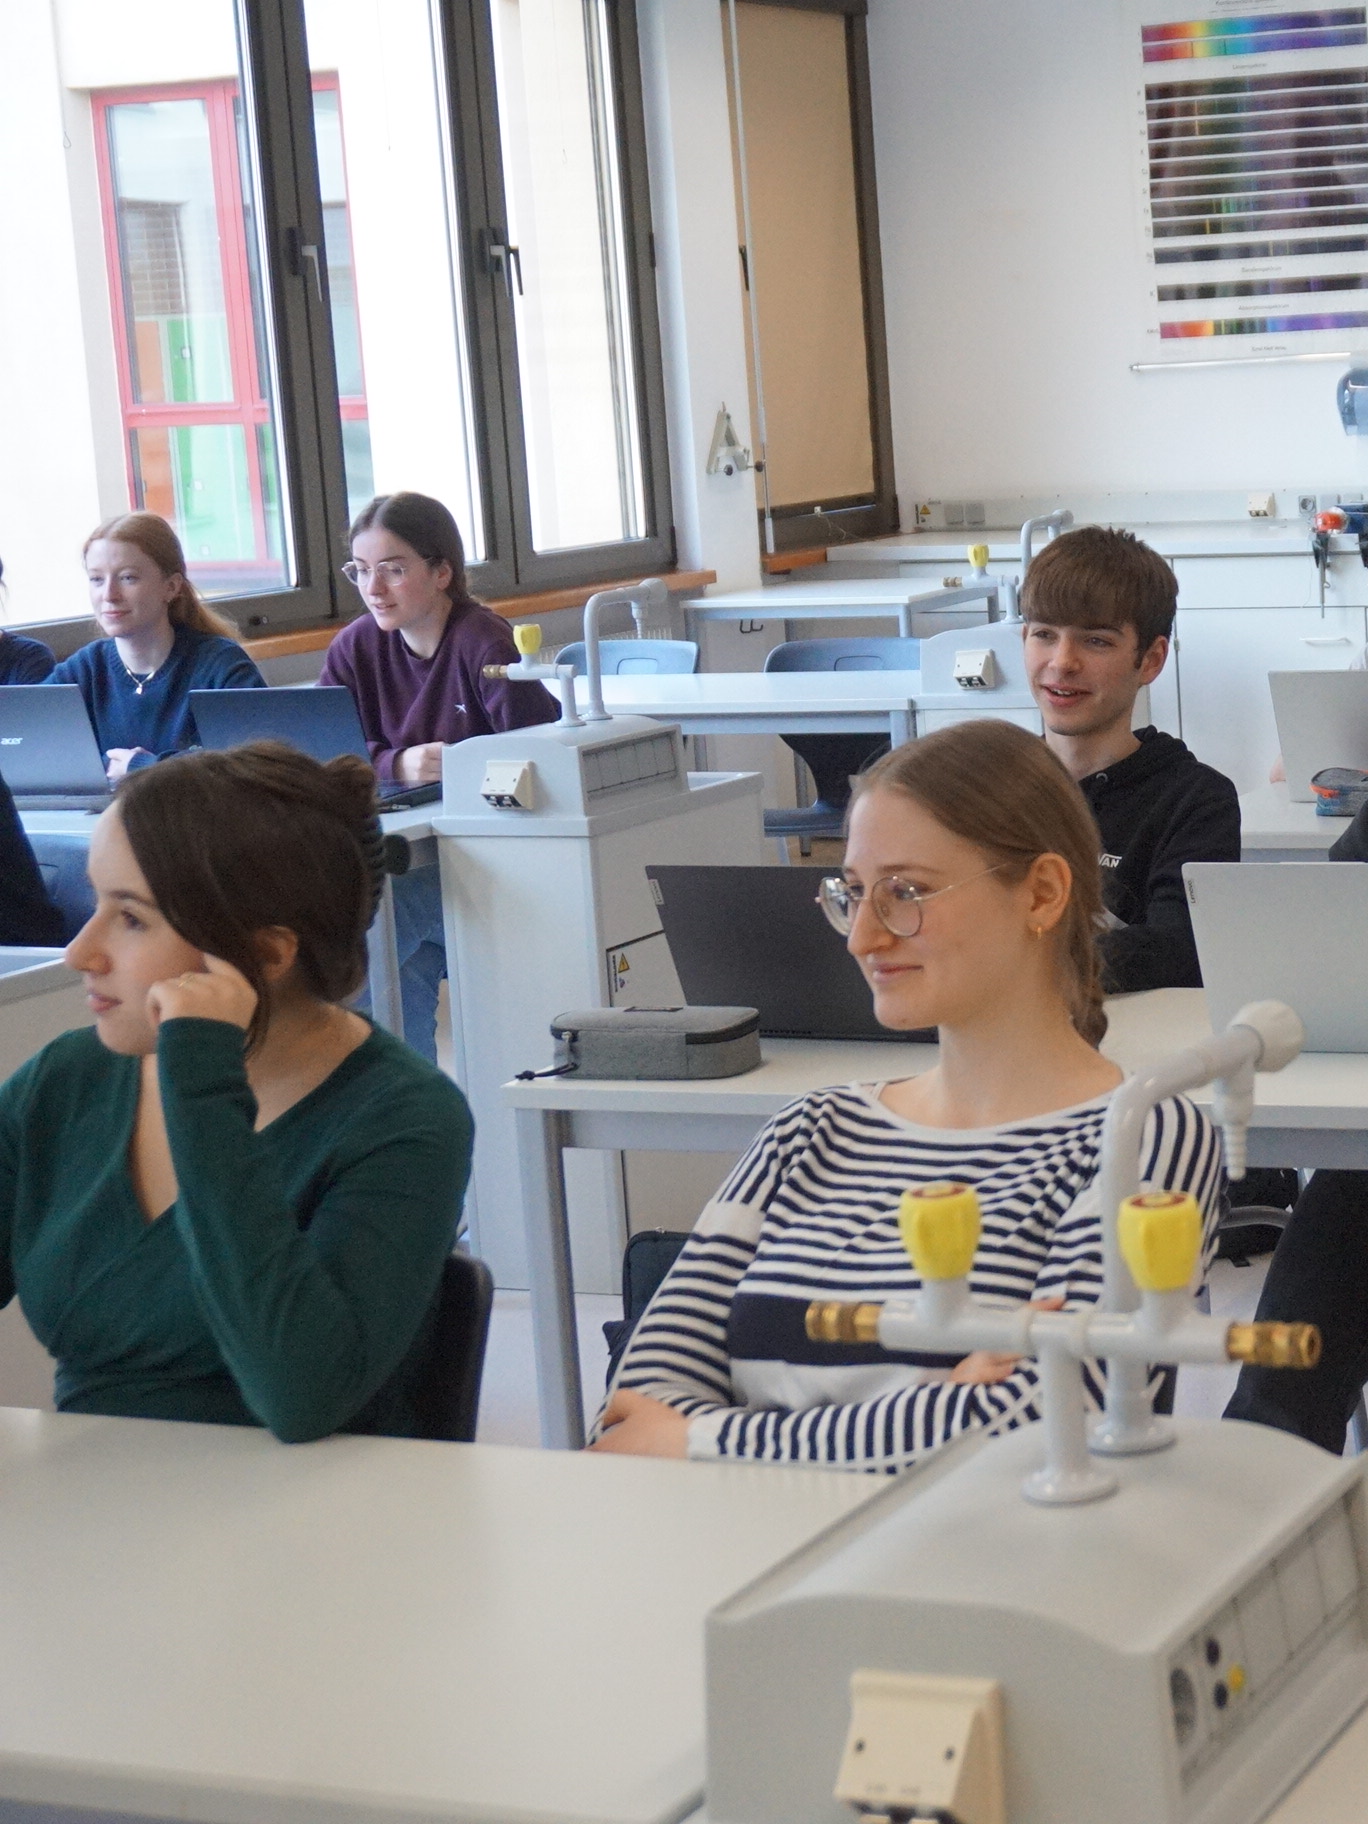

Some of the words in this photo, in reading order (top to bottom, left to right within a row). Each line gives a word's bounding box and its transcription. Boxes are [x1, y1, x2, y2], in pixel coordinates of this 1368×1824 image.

[1, 737, 23, 745] acer
[1099, 853, 1122, 868] VAN
[1187, 880, 1196, 904] Lenovo
